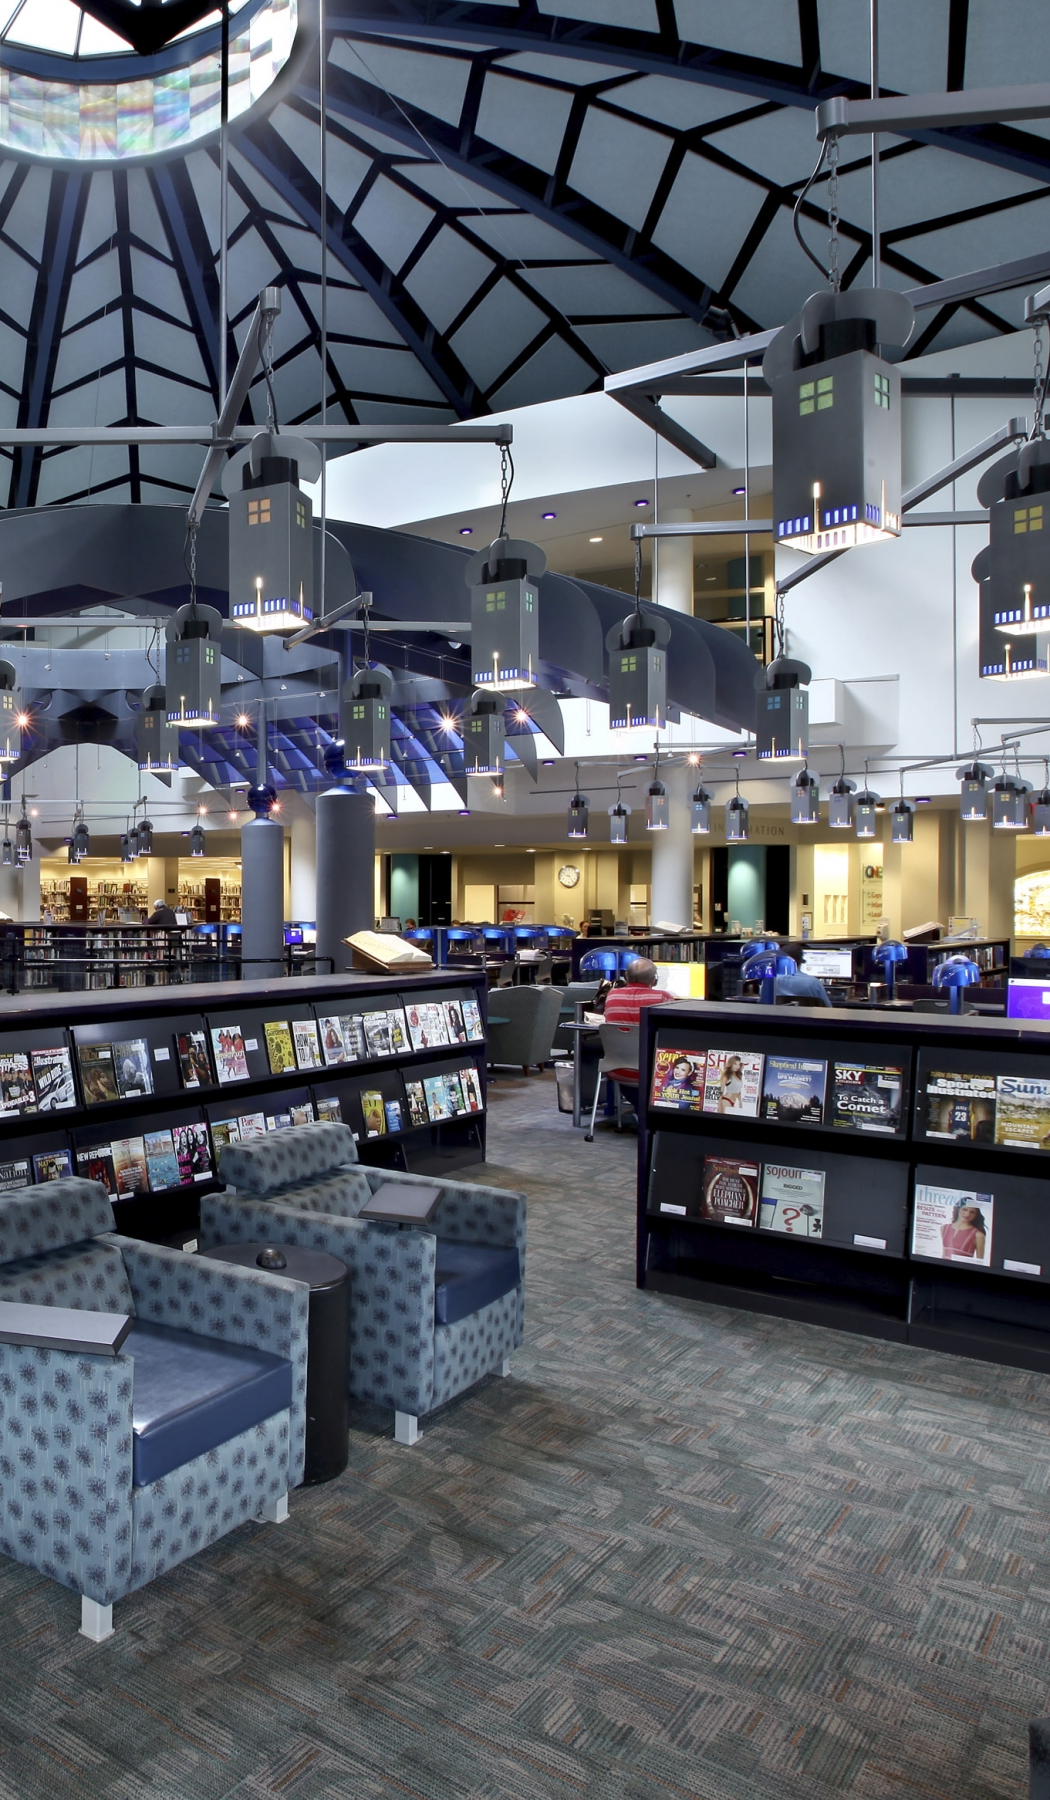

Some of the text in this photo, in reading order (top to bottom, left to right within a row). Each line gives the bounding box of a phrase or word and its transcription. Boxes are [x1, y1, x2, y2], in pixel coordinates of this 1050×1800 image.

[713, 822, 785, 836] INATION
[708, 1053, 760, 1071] SHE
[835, 1069, 862, 1080] SKY
[936, 1078, 985, 1090] Sports
[29, 1090, 35, 1102] 3
[926, 1083, 996, 1099] Illustrated
[851, 1095, 876, 1104] Catch
[836, 1101, 886, 1114] Comet
[954, 1111, 967, 1122] 23
[1000, 1122, 1039, 1130] MOUNTAIN
[76, 1151, 88, 1162] NEW
[783, 1183, 803, 1191] RIGGED
[713, 1188, 747, 1201] ELEPHANT
[922, 1211, 946, 1219] PATTERN
